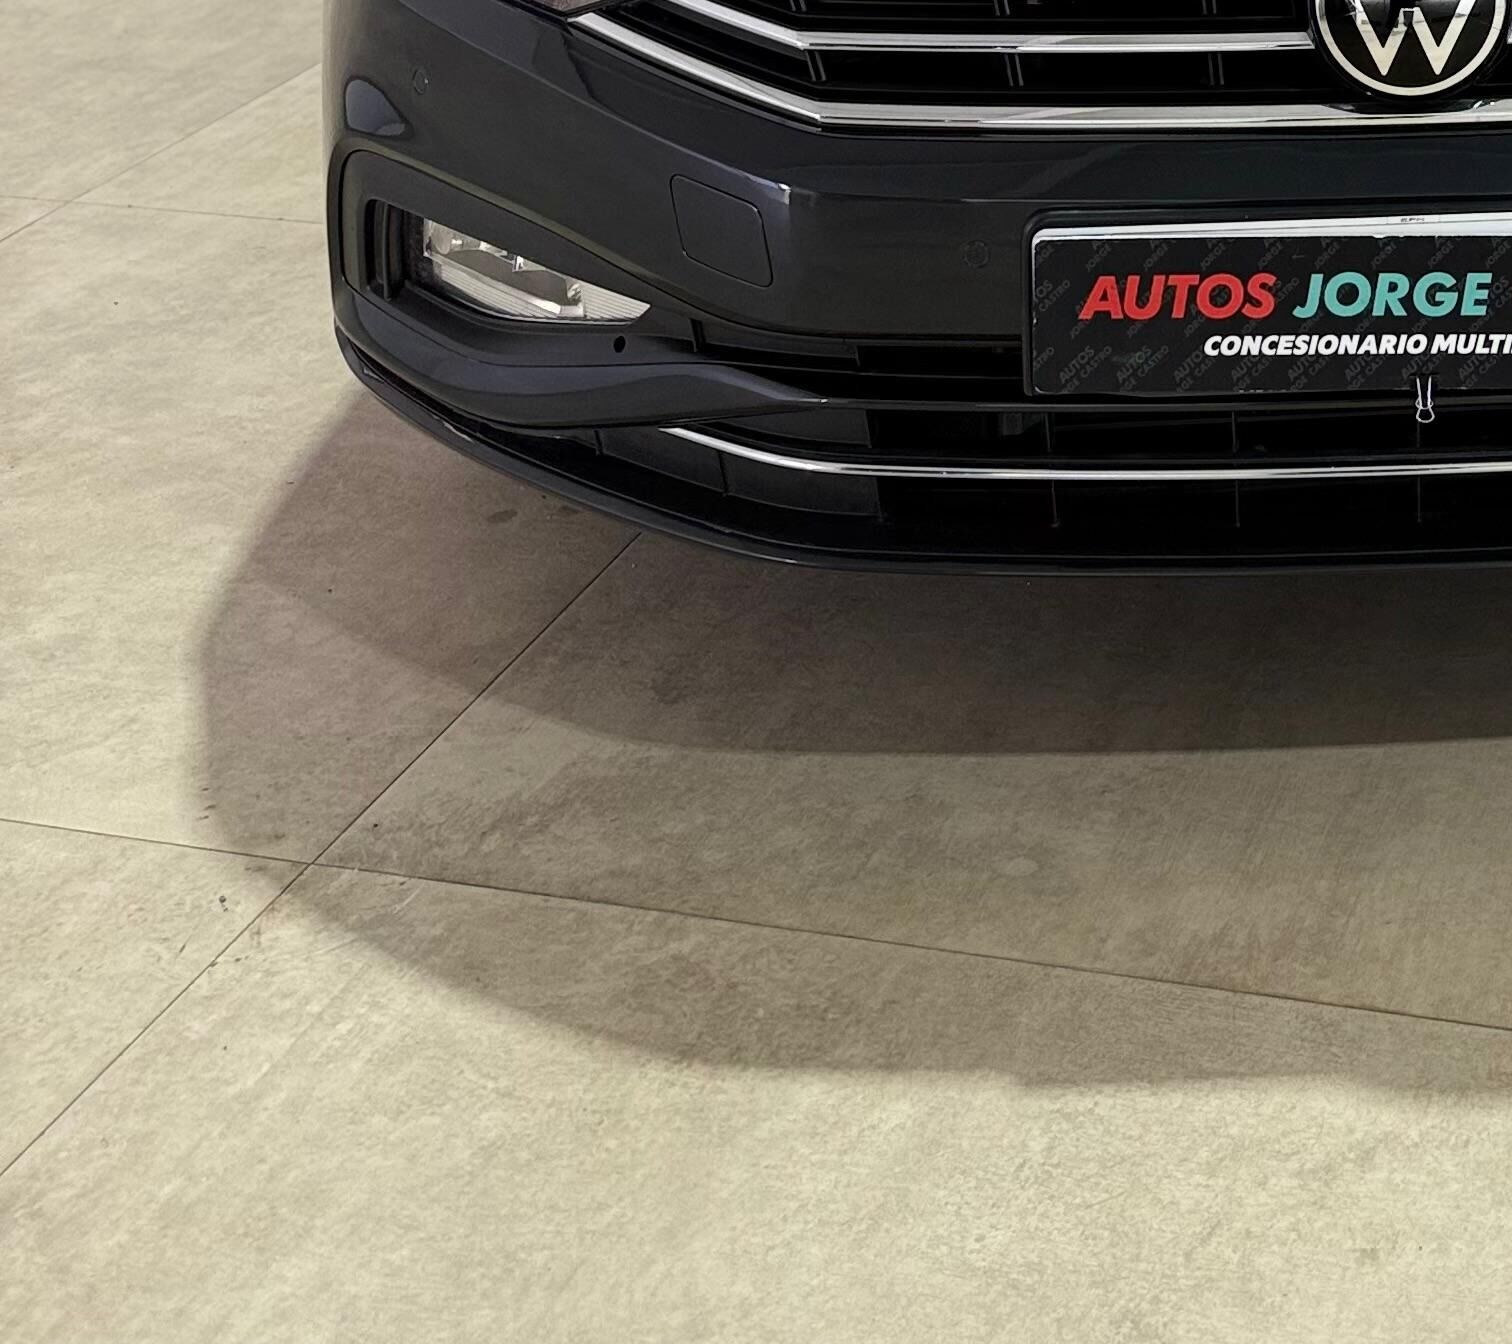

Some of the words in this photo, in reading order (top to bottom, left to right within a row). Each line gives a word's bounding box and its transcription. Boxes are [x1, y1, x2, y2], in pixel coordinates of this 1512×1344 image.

[1078, 272, 1278, 320] AUTOS
[1292, 272, 1493, 319] JORGE
[1203, 334, 1428, 356] CONCESIONARIO
